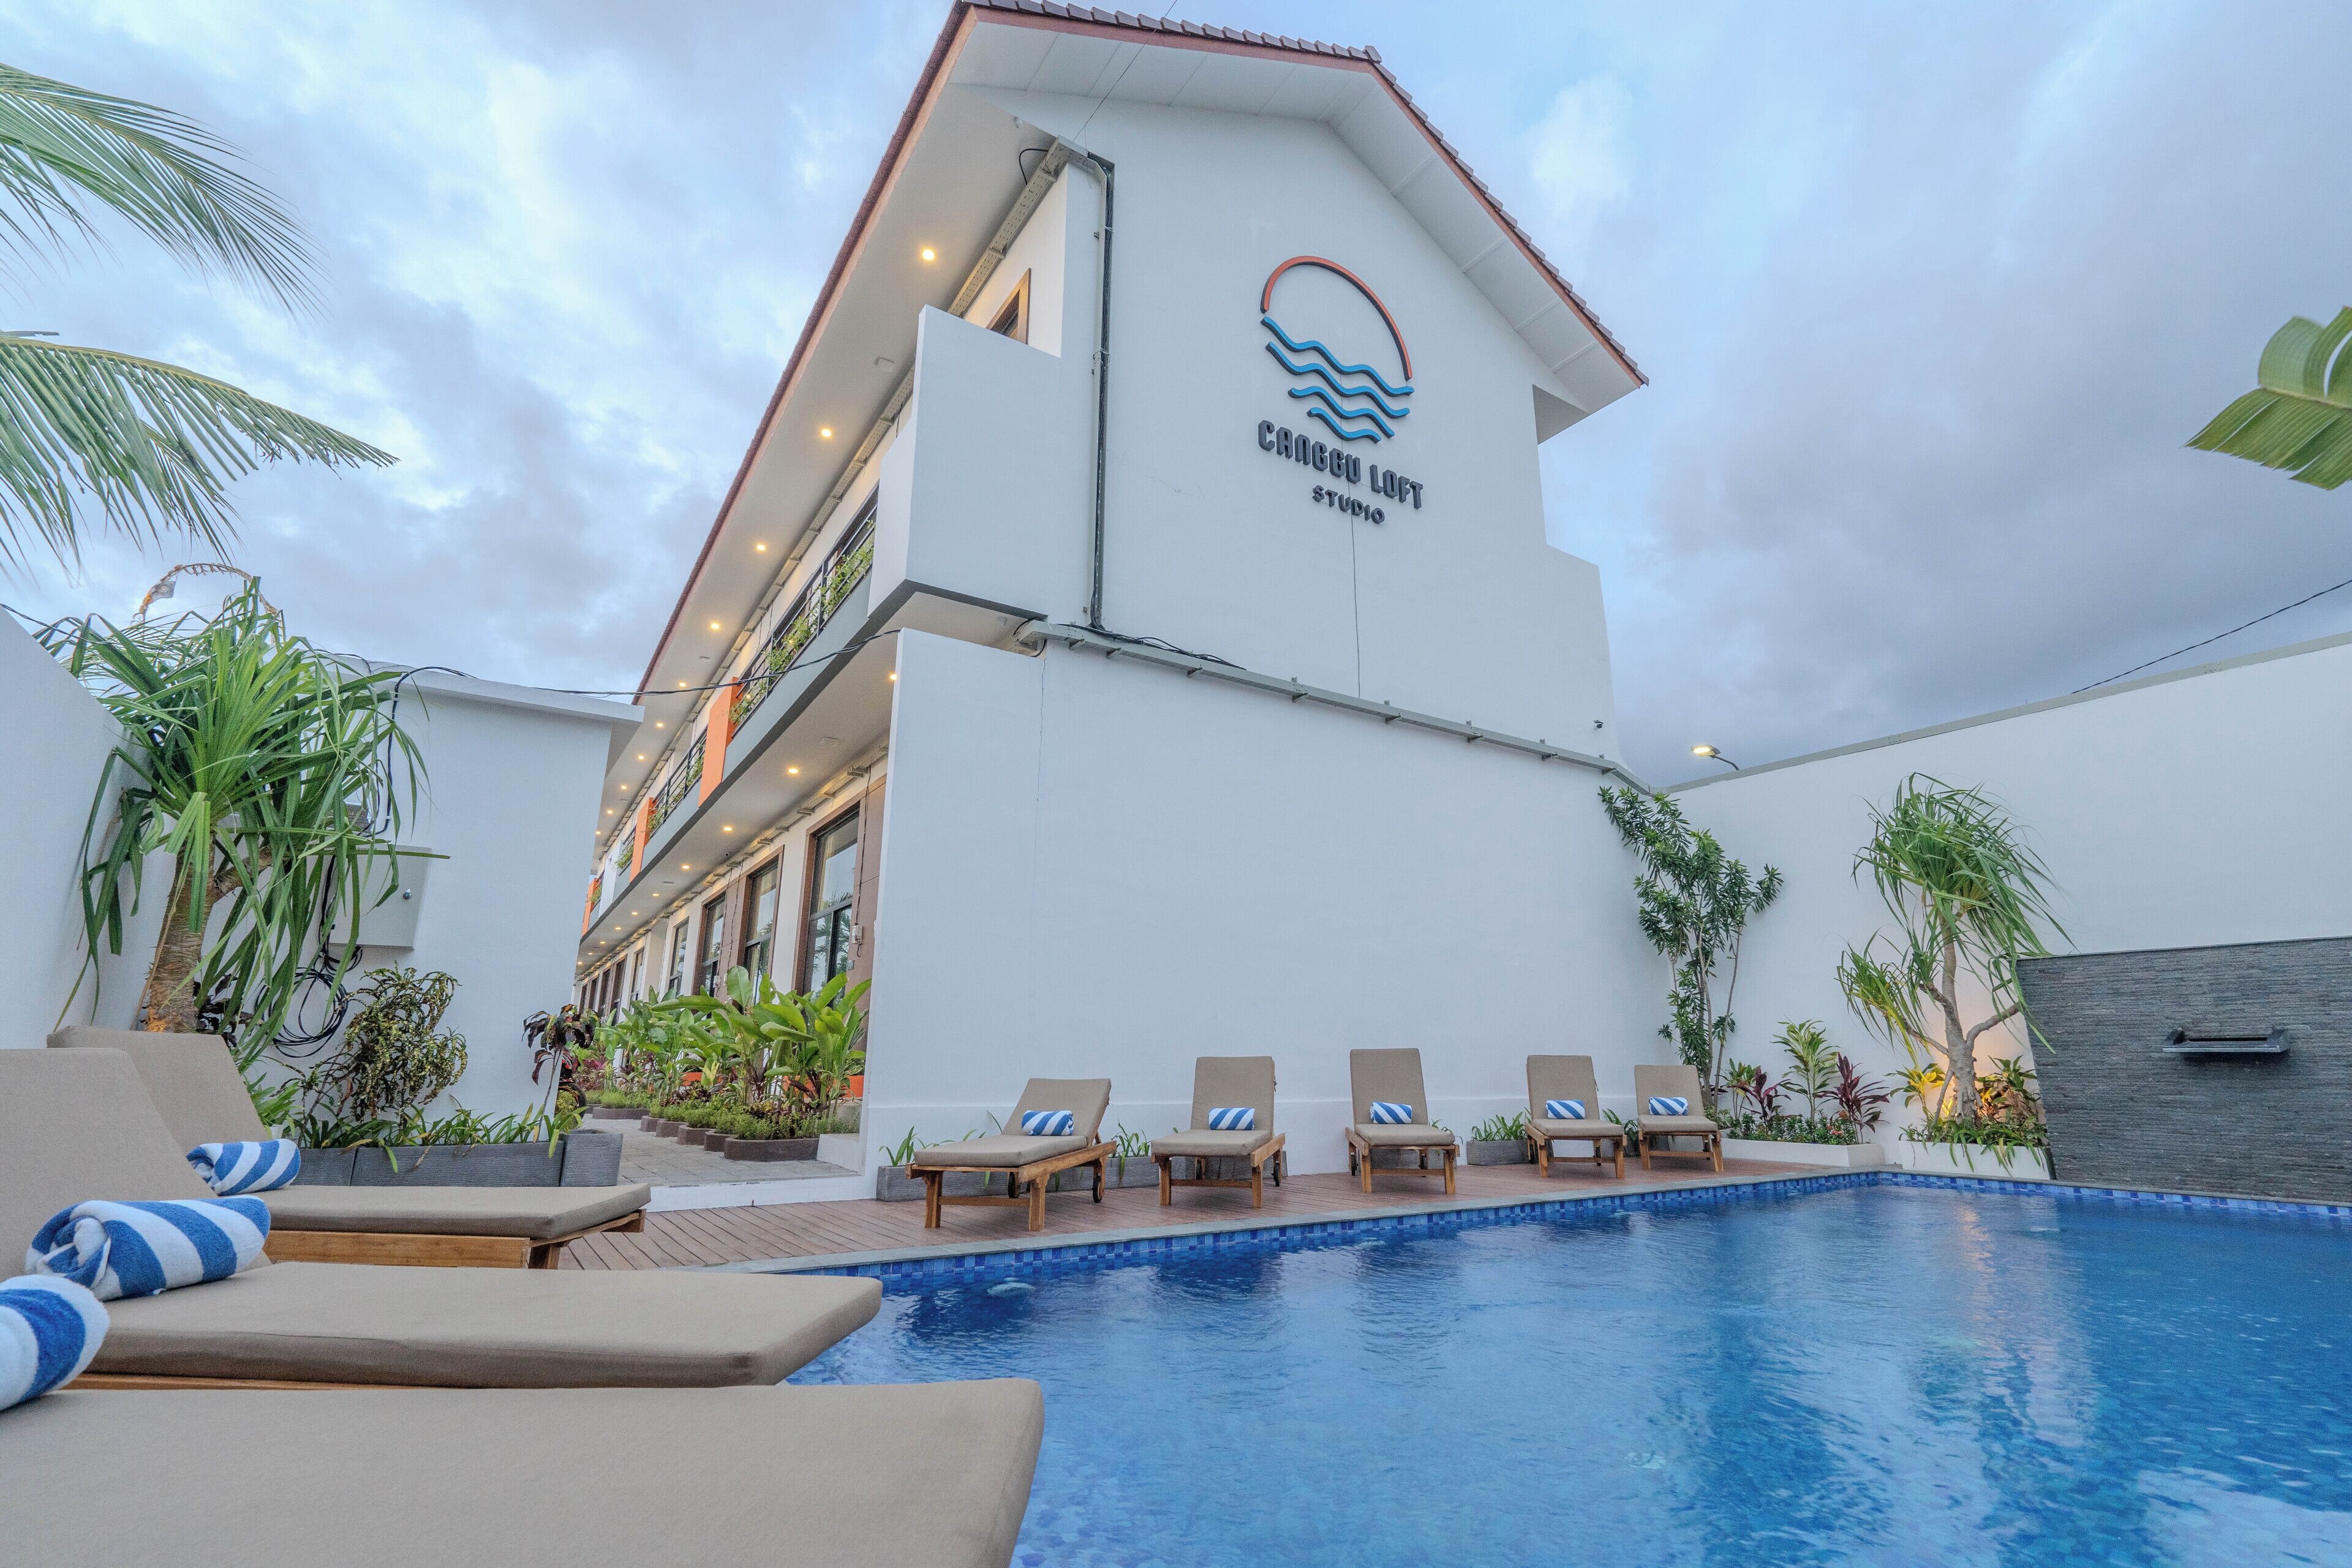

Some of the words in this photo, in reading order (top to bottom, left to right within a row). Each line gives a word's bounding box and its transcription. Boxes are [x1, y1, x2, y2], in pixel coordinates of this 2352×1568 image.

[1258, 420, 1361, 484] CANGGU
[1370, 464, 1423, 509] LOFT
[1312, 484, 1385, 524] STUDIO
